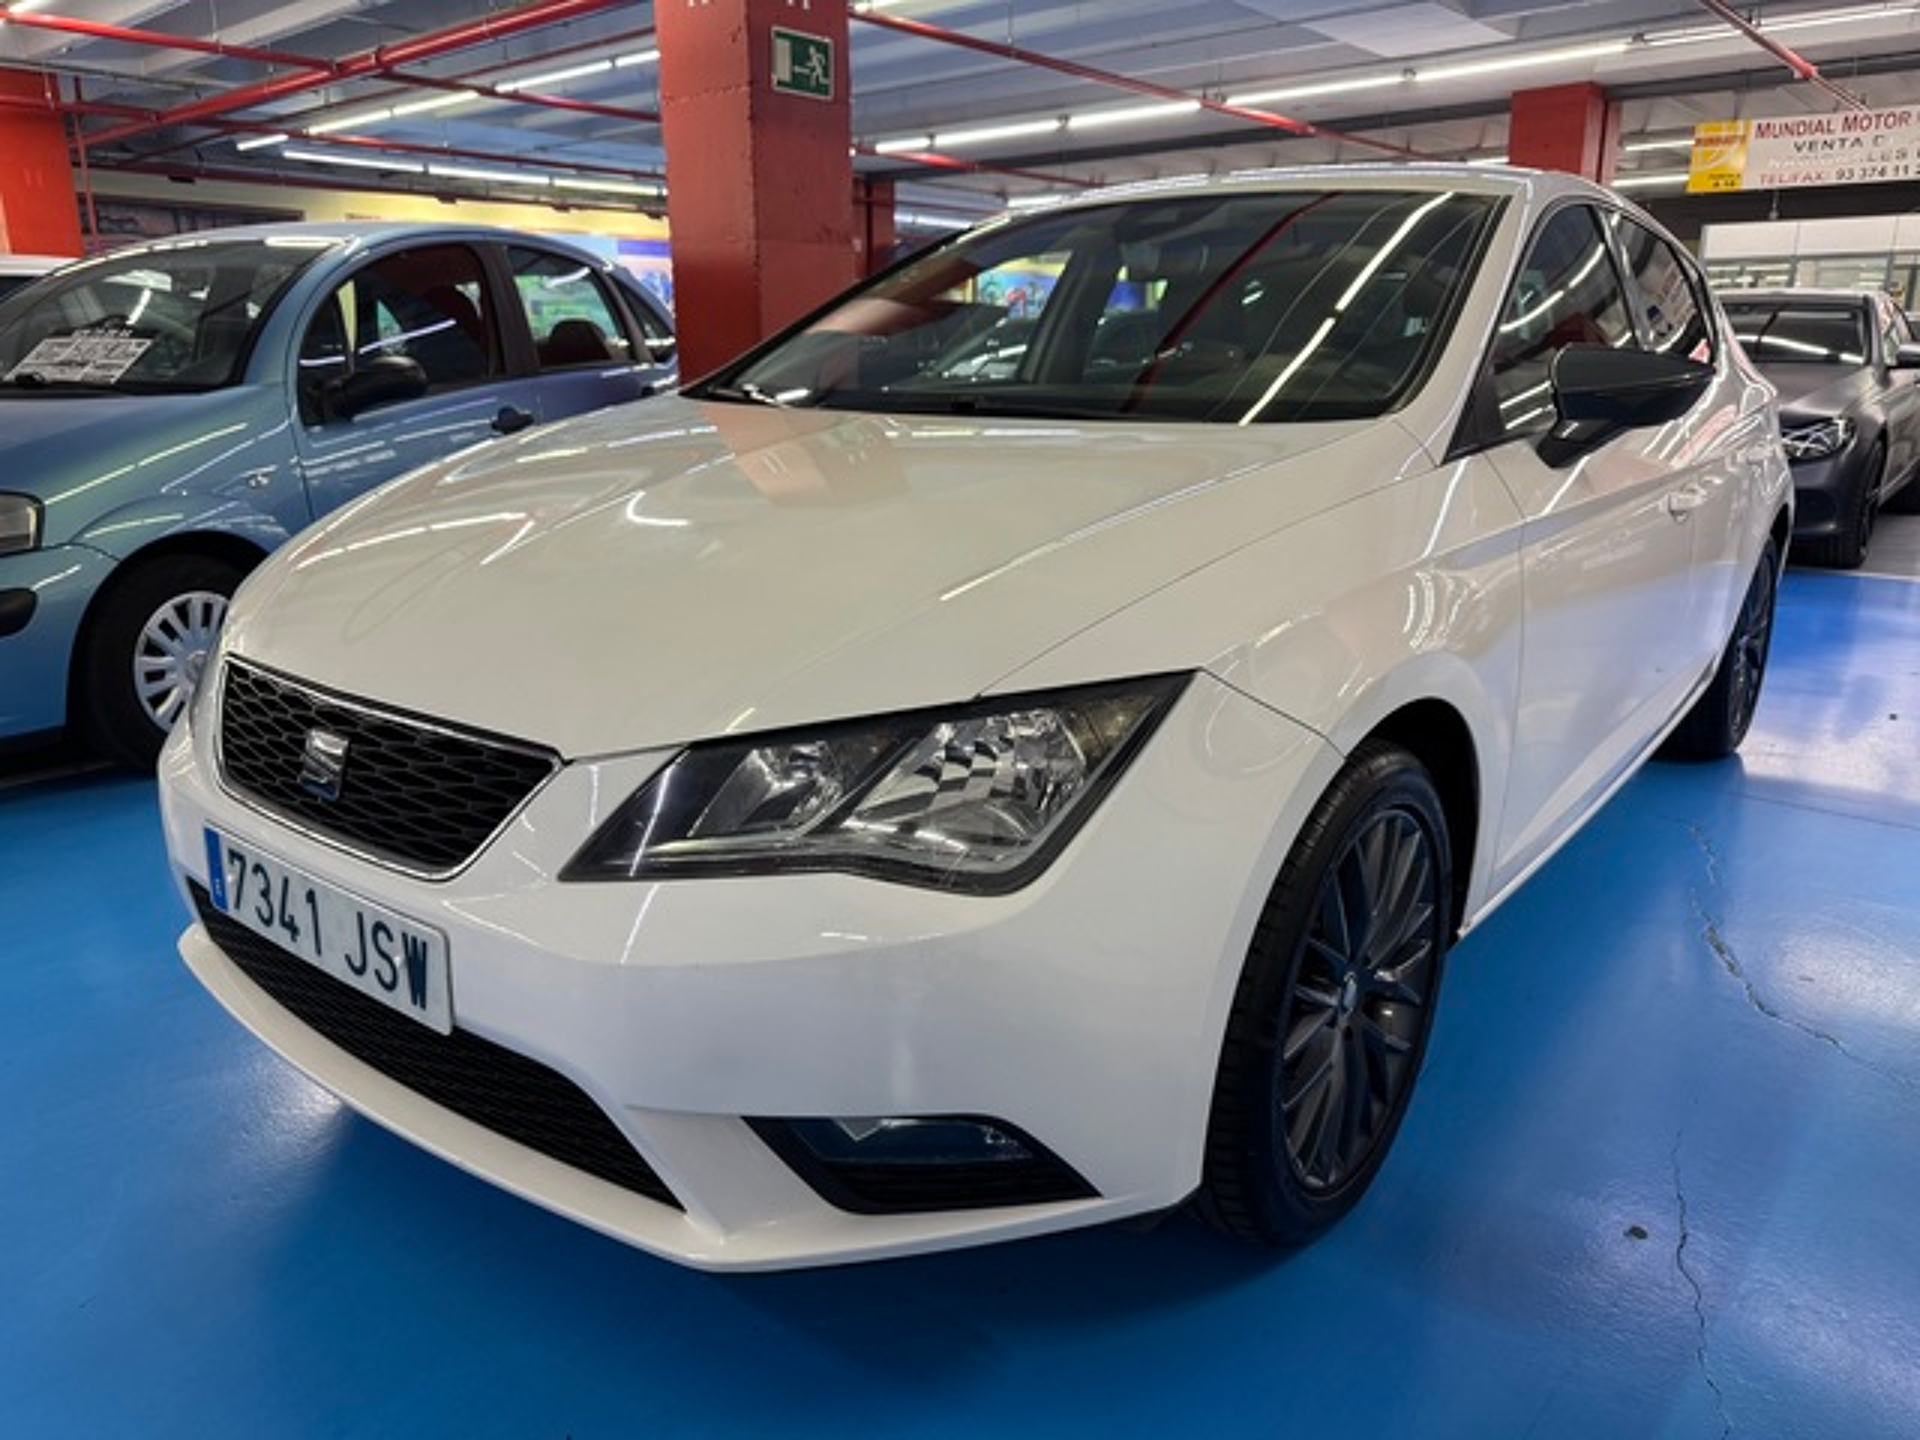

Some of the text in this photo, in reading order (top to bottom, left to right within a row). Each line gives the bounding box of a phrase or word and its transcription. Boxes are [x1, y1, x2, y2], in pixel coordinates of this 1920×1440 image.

[1755, 119, 1835, 139] MUNDIAL
[1841, 111, 1912, 133] MOTOR
[1793, 136, 1863, 153] VENTA
[1836, 168, 1854, 181] 93
[227, 847, 428, 1011] 7341 JSW
